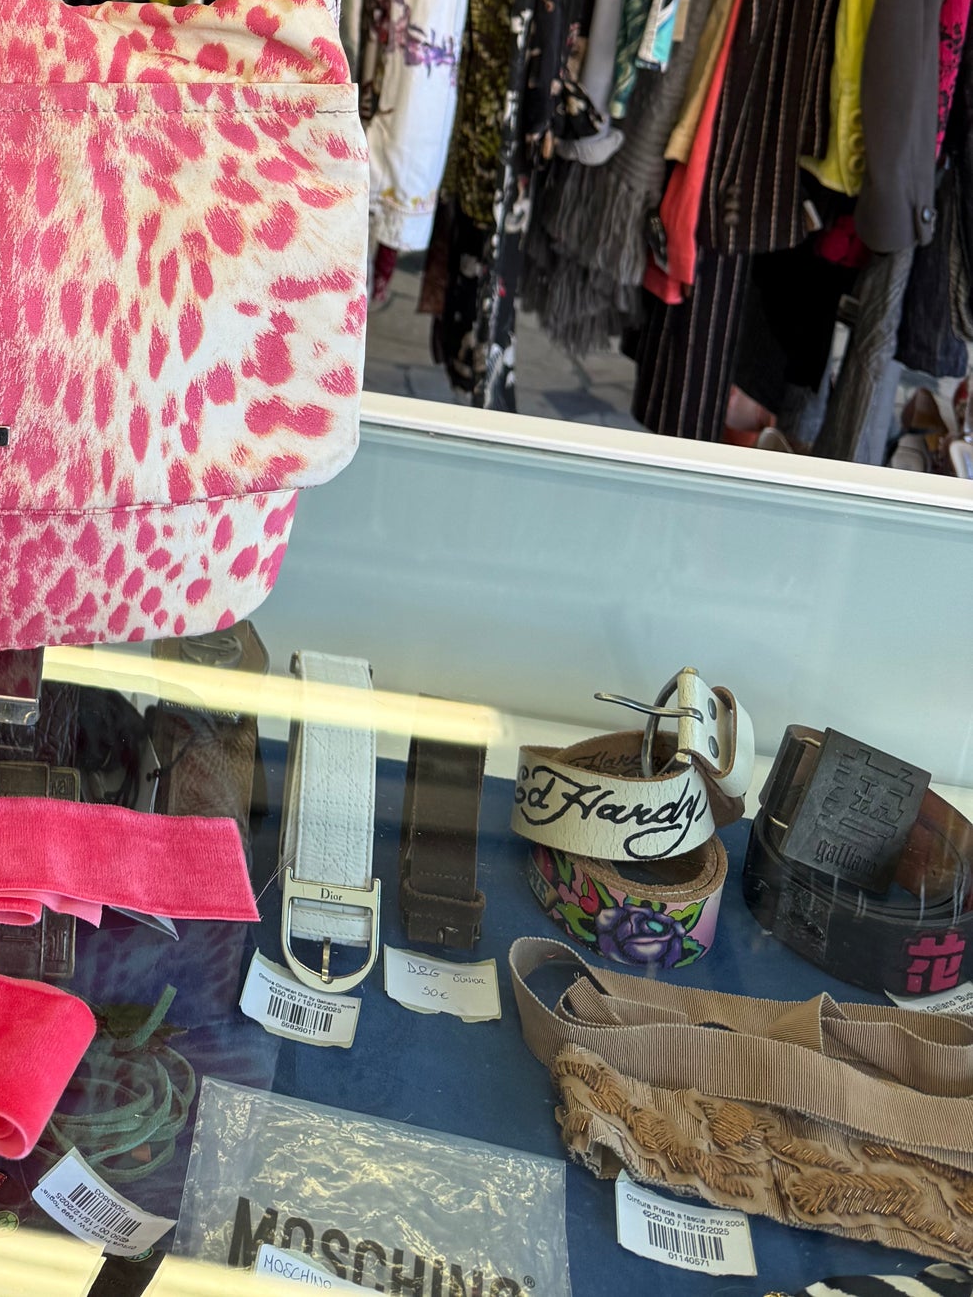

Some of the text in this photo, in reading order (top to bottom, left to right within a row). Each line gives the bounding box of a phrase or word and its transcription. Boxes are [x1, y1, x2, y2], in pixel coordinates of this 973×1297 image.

[521, 764, 709, 860] Hardy
[320, 887, 343, 901] Dior
[407, 961, 441, 978] D&G
[302, 999, 342, 1014] 15/12/2025
[61, 1209, 77, 1223] 1999
[626, 1193, 651, 1210] Cintura
[653, 1204, 675, 1217] Prada
[725, 1220, 745, 1228] 2004
[683, 1222, 730, 1236] 15/12/2025
[227, 1196, 523, 1297] MOSCHI
[668, 1251, 710, 1267] 01140571
[263, 1254, 332, 1289] MOSCHINO
